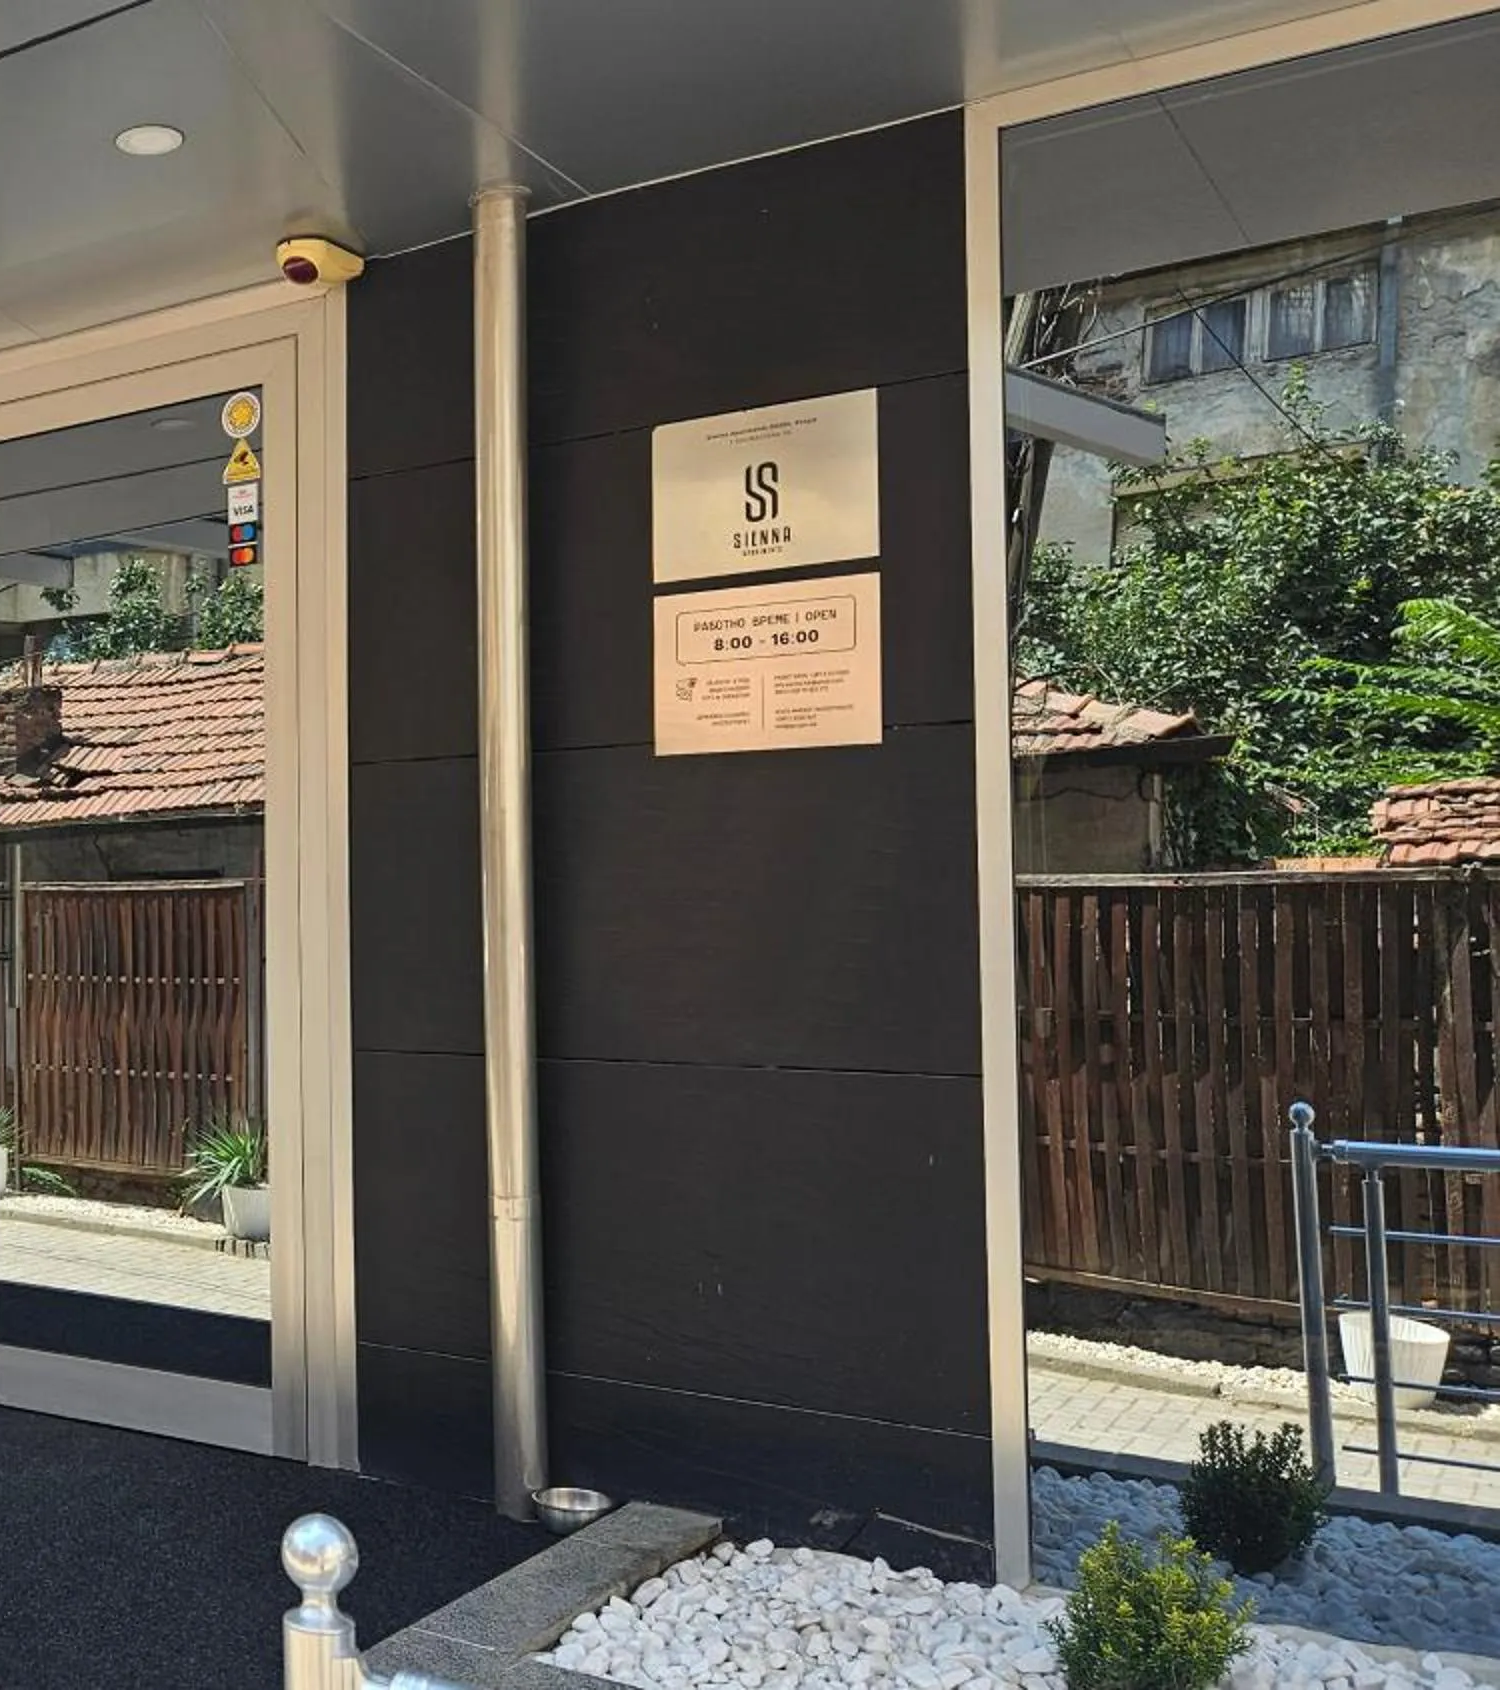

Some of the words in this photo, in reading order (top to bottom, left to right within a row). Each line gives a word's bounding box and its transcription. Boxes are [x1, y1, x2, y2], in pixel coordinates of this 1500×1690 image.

[233, 504, 254, 517] VISA
[733, 526, 792, 549] SIENNA
[805, 608, 837, 622] OPEN
[713, 635, 753, 651] 8:00
[771, 629, 820, 646] 16:00
